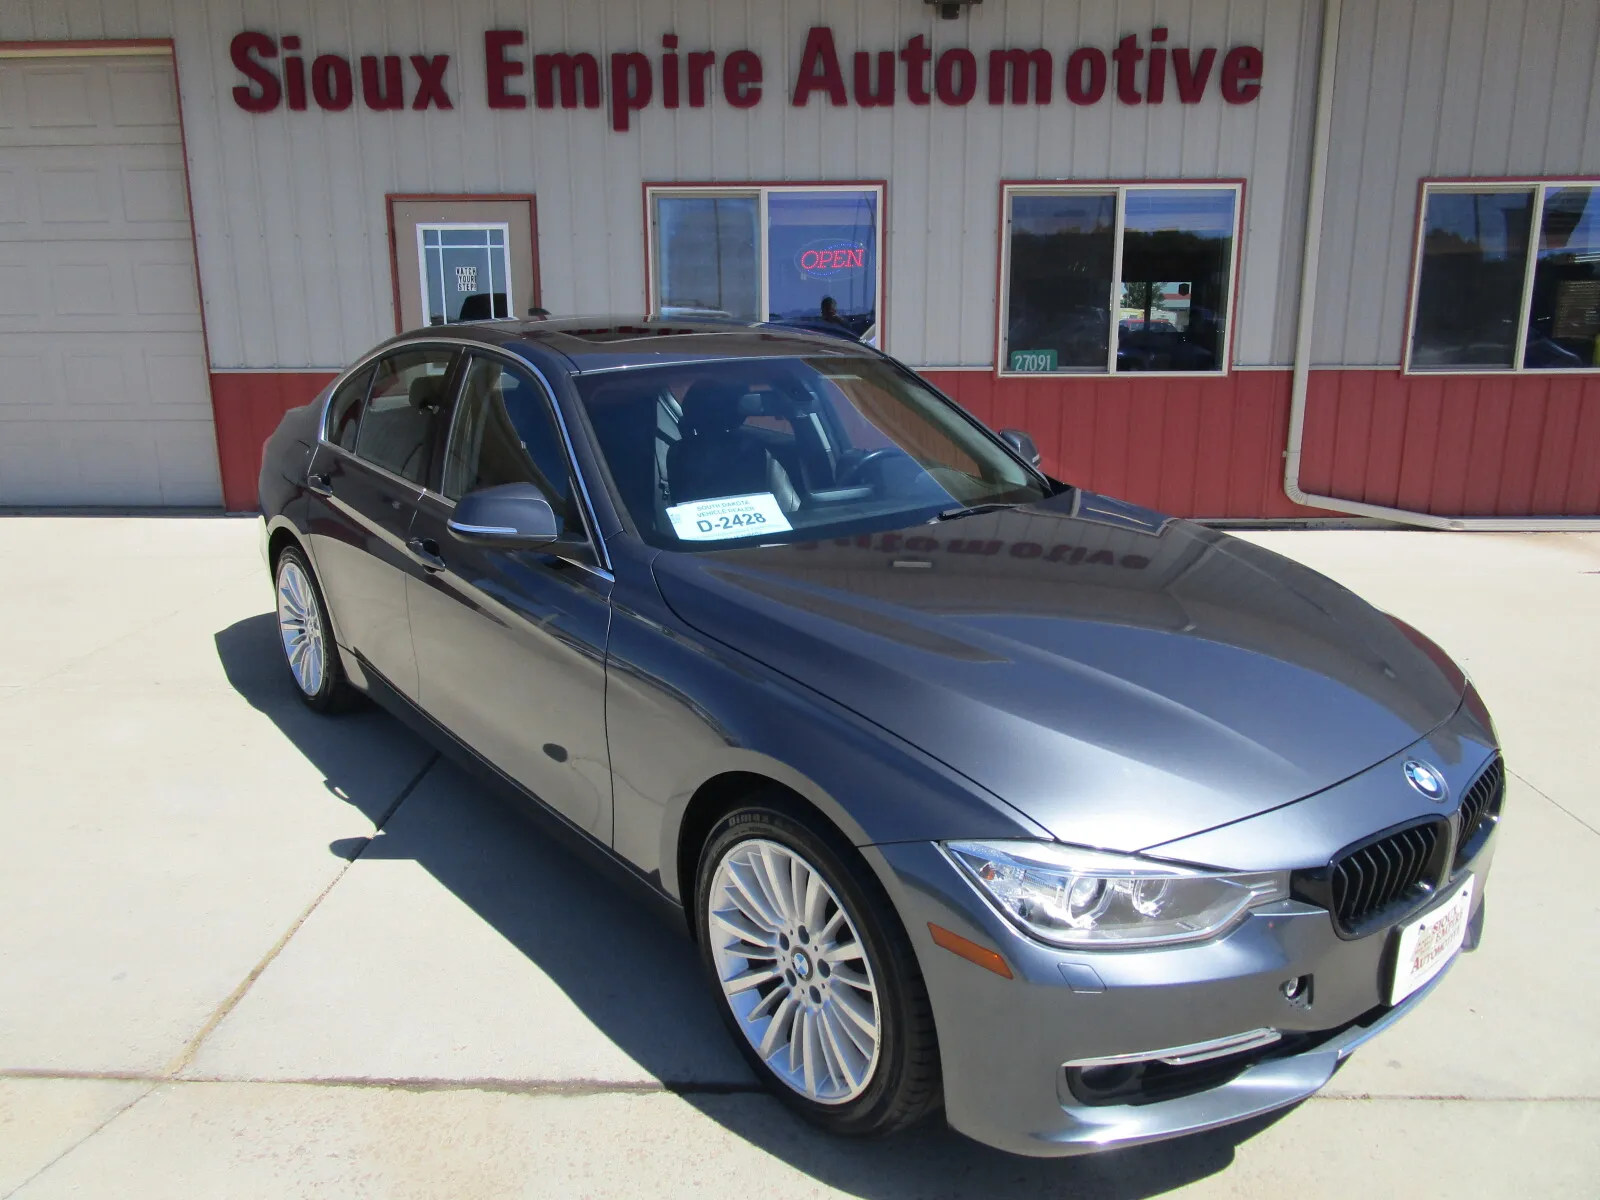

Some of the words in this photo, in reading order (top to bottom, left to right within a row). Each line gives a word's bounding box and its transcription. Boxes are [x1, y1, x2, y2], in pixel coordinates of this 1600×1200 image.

[230, 31, 454, 112] Sioux
[484, 30, 763, 131] Empire
[792, 26, 1264, 107] Automotive
[801, 249, 864, 269] OPEN
[1015, 354, 1051, 372] 27091
[696, 503, 721, 511] SOUTH
[696, 512, 766, 532] D-2428
